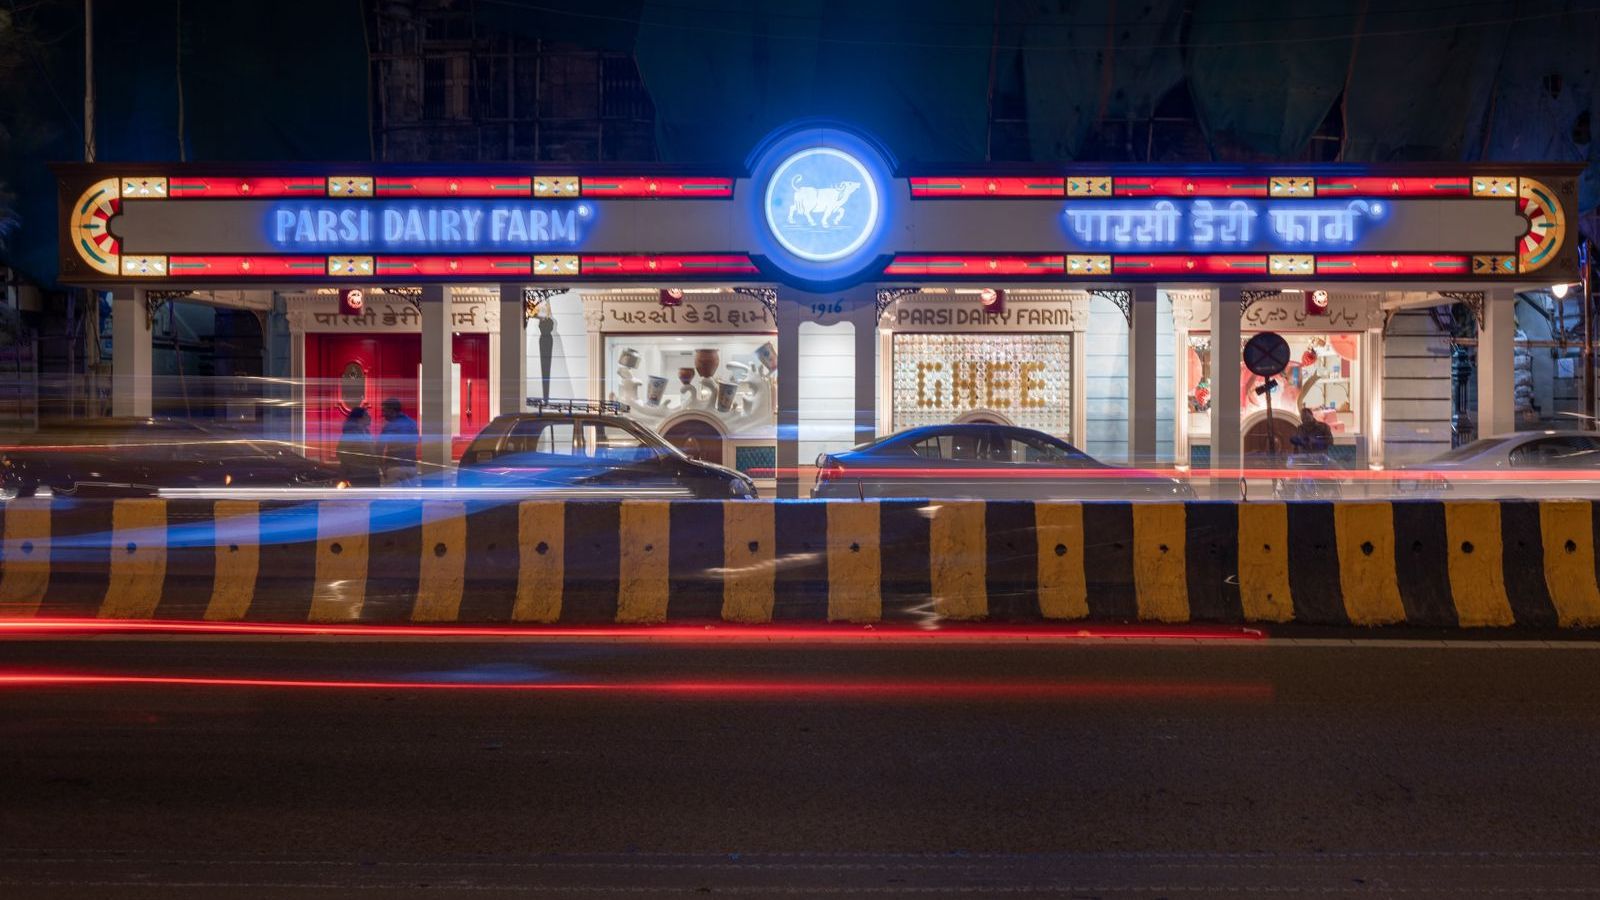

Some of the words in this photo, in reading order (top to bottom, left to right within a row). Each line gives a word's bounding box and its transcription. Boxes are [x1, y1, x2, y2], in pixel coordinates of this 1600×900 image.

[276, 209, 370, 242] PARSI
[384, 209, 481, 242] DAIRY
[1065, 200, 1182, 242] पारसी
[1191, 200, 1258, 242] डेरी
[811, 298, 843, 319] 1916
[897, 308, 953, 325] PARSI
[957, 308, 1012, 325] DAIRY
[1017, 308, 1069, 325] FARM
[917, 361, 1045, 408] GHEE
